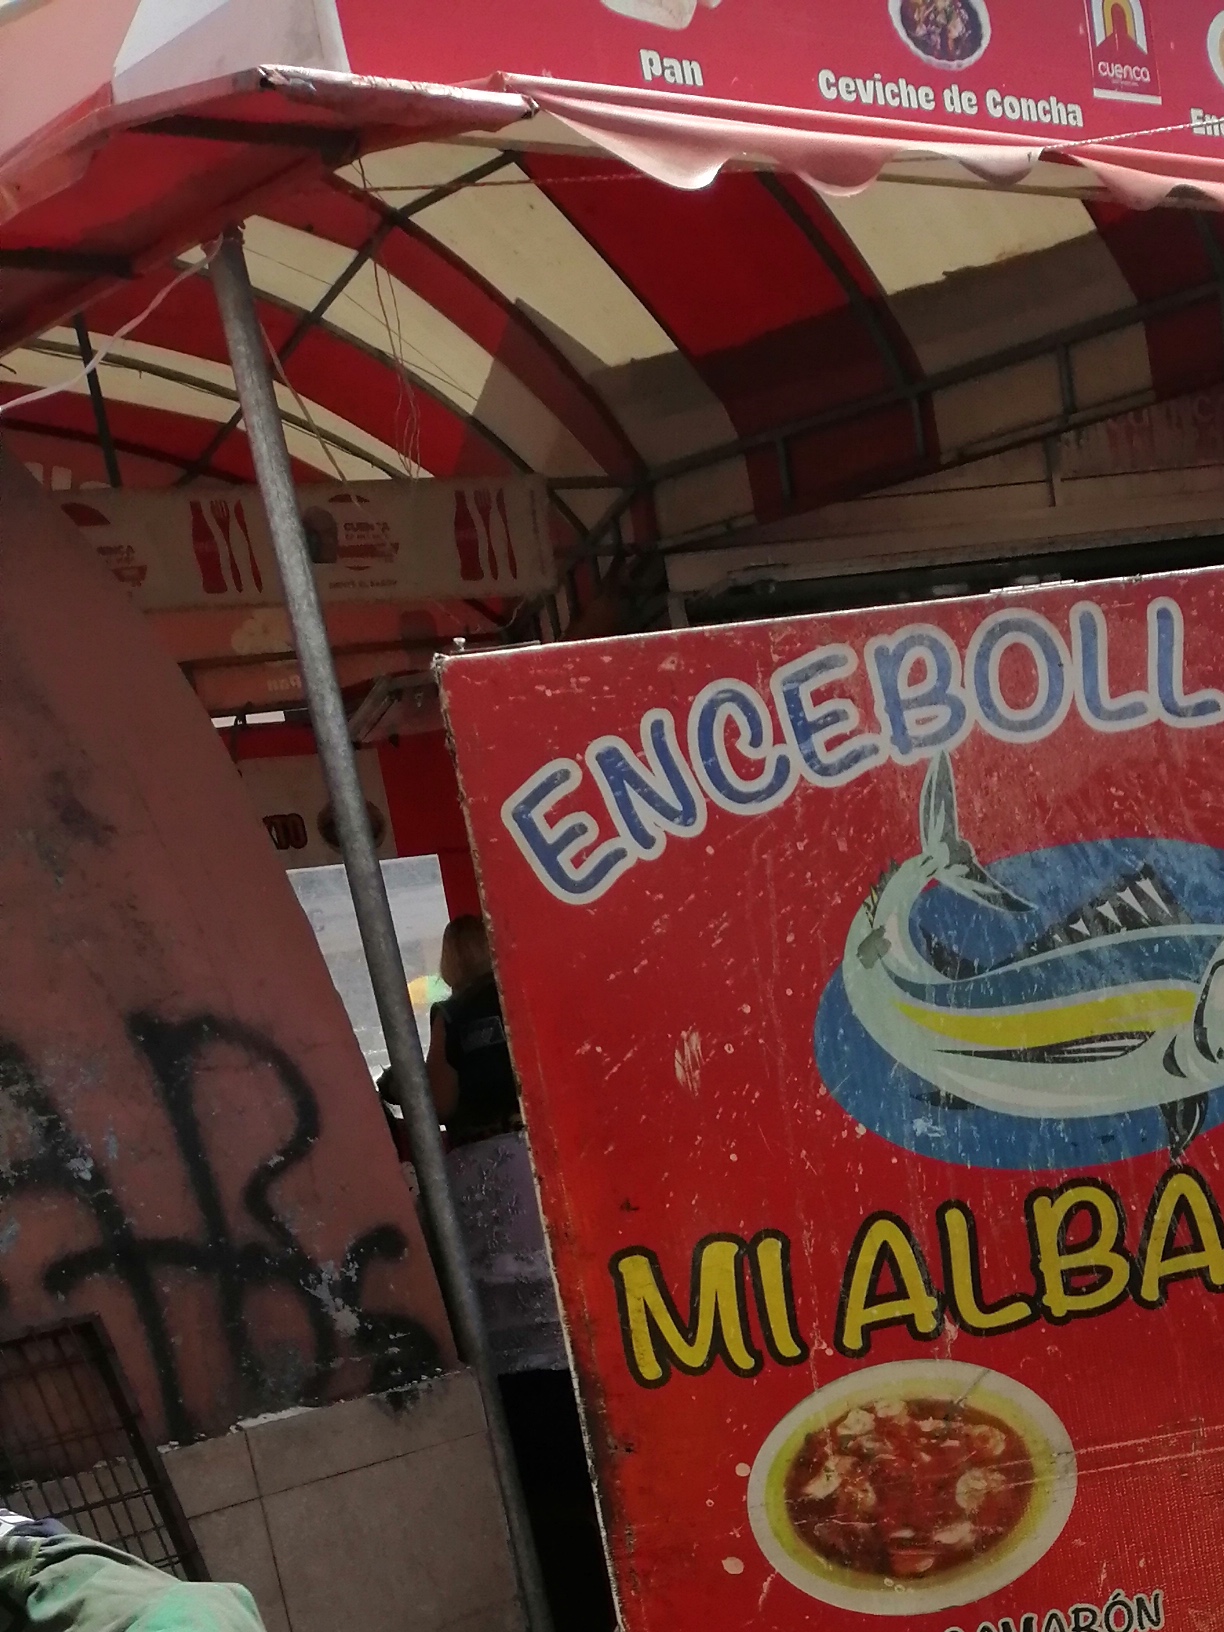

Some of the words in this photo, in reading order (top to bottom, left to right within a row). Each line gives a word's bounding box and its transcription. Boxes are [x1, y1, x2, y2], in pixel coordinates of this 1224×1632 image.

[639, 48, 704, 87] Pan
[818, 69, 936, 111] Ceviche
[942, 84, 979, 115] de
[985, 88, 1084, 128] Concha
[609, 1228, 808, 1389] MI
